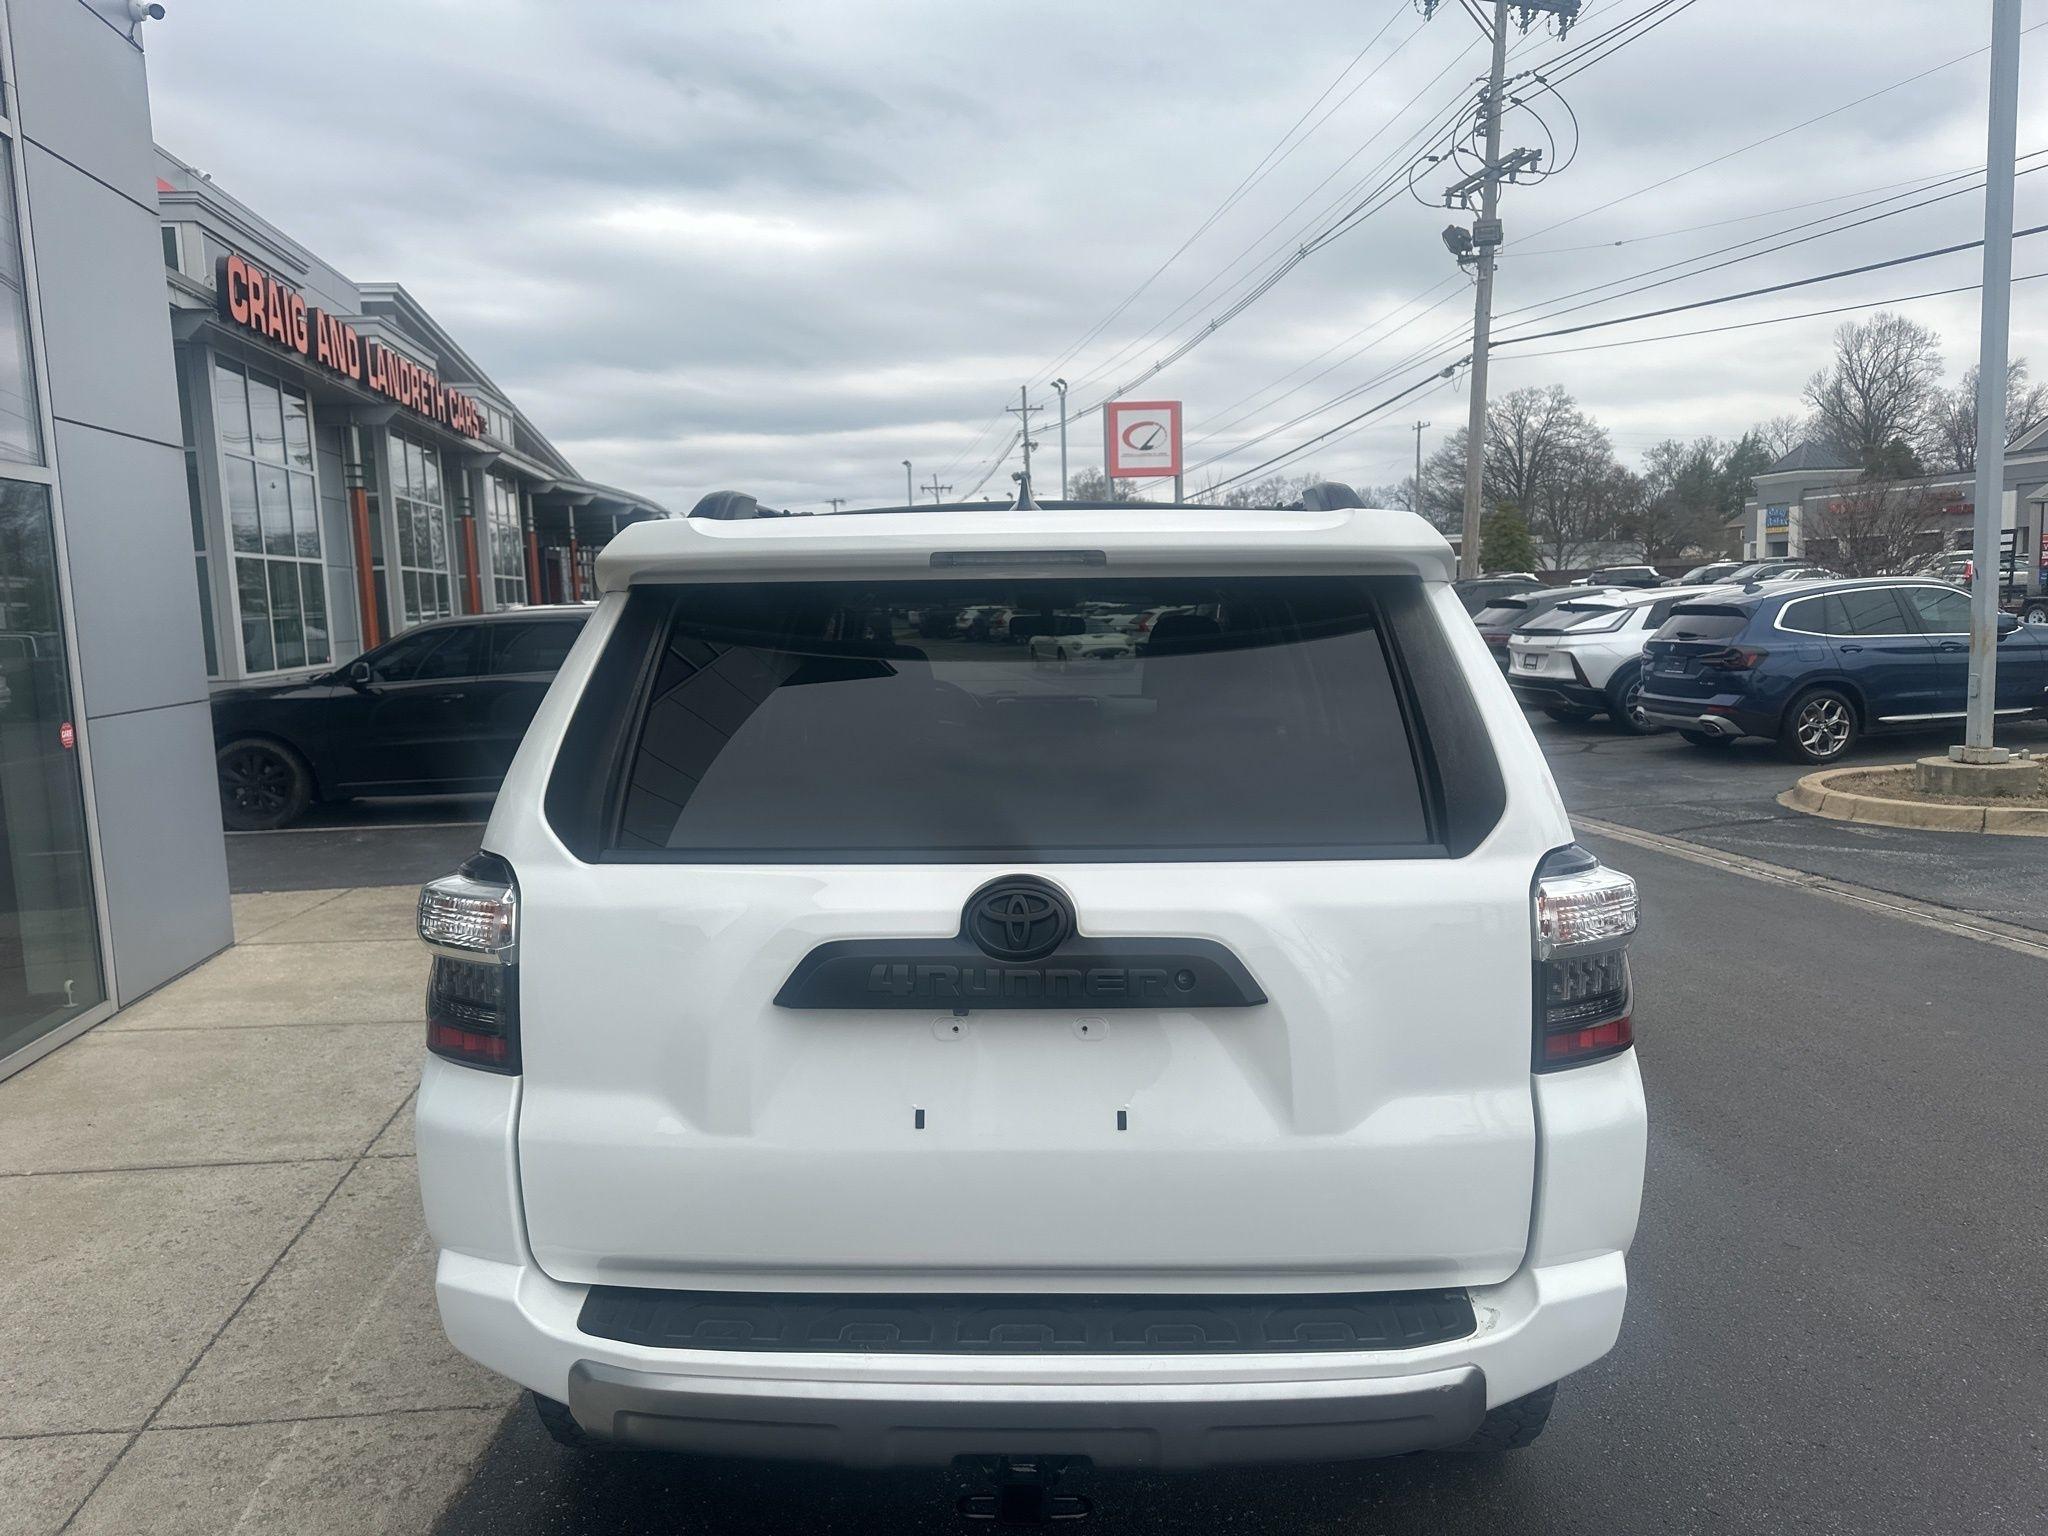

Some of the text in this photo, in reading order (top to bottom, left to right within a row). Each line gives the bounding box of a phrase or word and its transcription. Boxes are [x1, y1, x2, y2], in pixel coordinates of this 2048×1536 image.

[225, 255, 480, 440] CRAIG AND LANDRETH CARS
[867, 963, 1168, 998] 4RUNNER
